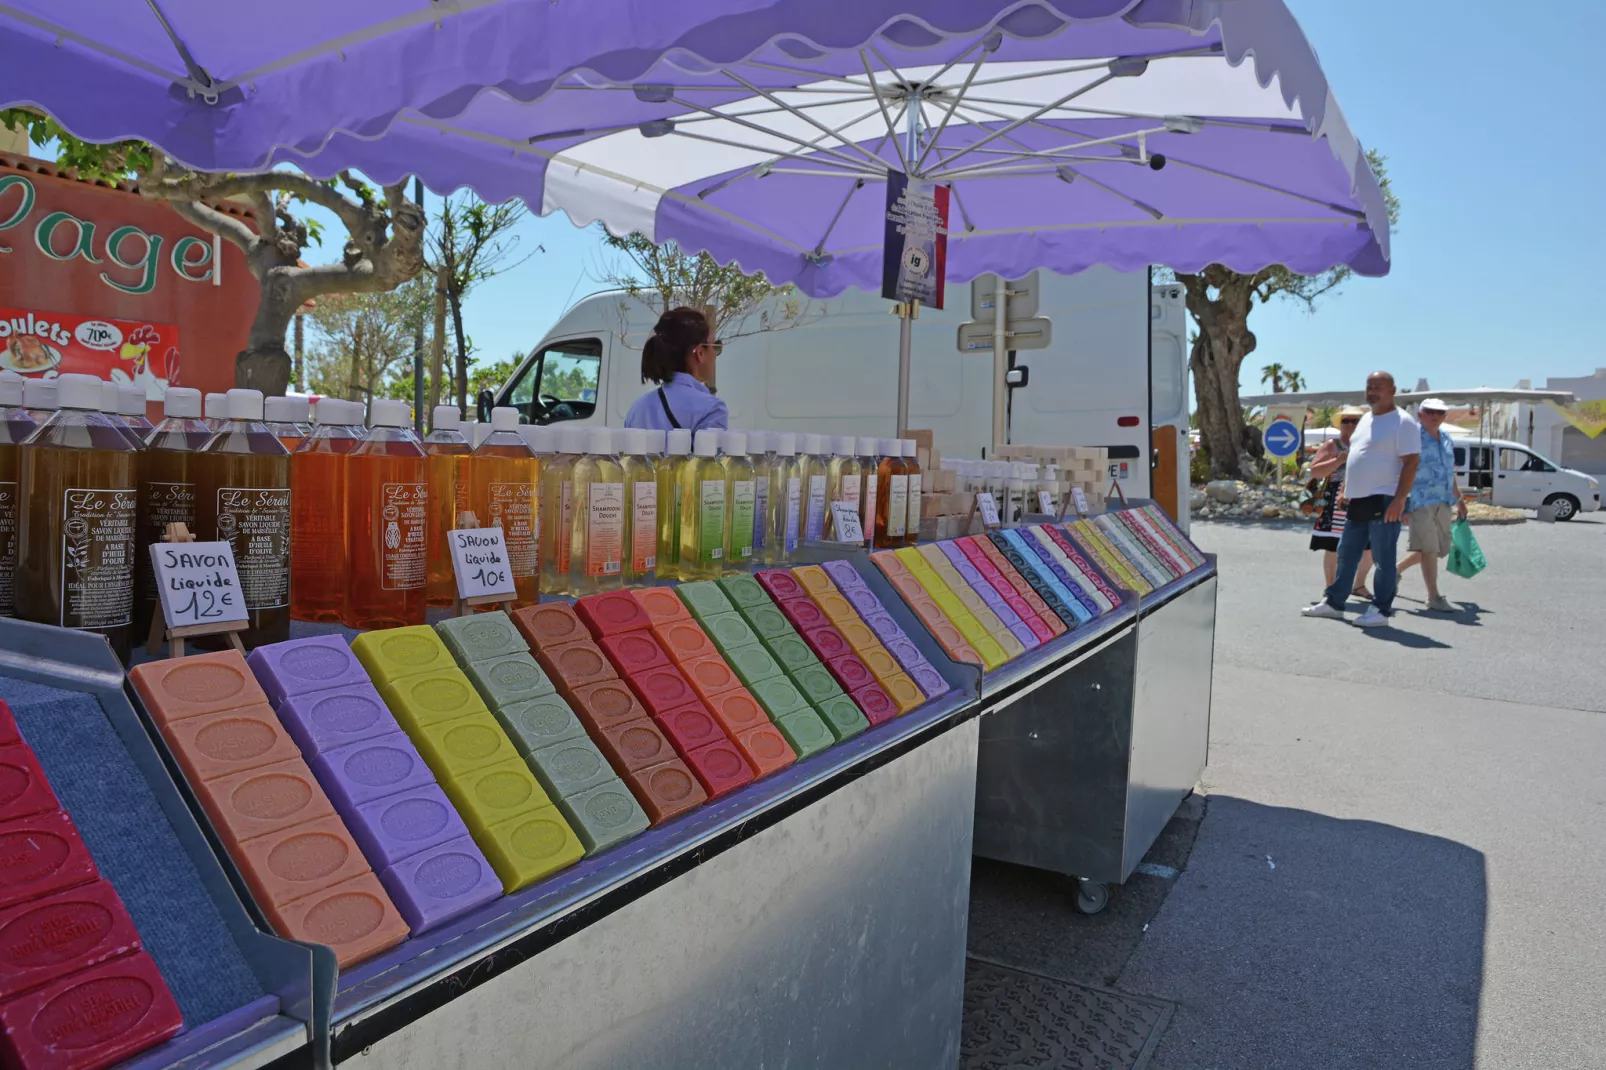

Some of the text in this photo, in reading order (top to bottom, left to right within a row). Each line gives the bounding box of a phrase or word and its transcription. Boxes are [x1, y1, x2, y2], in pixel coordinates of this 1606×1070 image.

[221, 491, 290, 507] Le Sérail
[386, 485, 410, 499] Le
[491, 485, 513, 497] Le
[70, 492, 107, 510] Le
[91, 527, 112, 535] SAVON
[165, 550, 230, 569] SAVON
[465, 552, 501, 565] Liquide
[171, 573, 233, 591] Liquide
[472, 569, 506, 588] 10€
[175, 589, 233, 620] 12€
[209, 734, 264, 752] JASMIN
[246, 788, 301, 811] JASMIN
[428, 868, 469, 887] LAVANDE
[43, 917, 102, 949] MARSEILLE
[83, 992, 145, 1027] MARSEILLE
